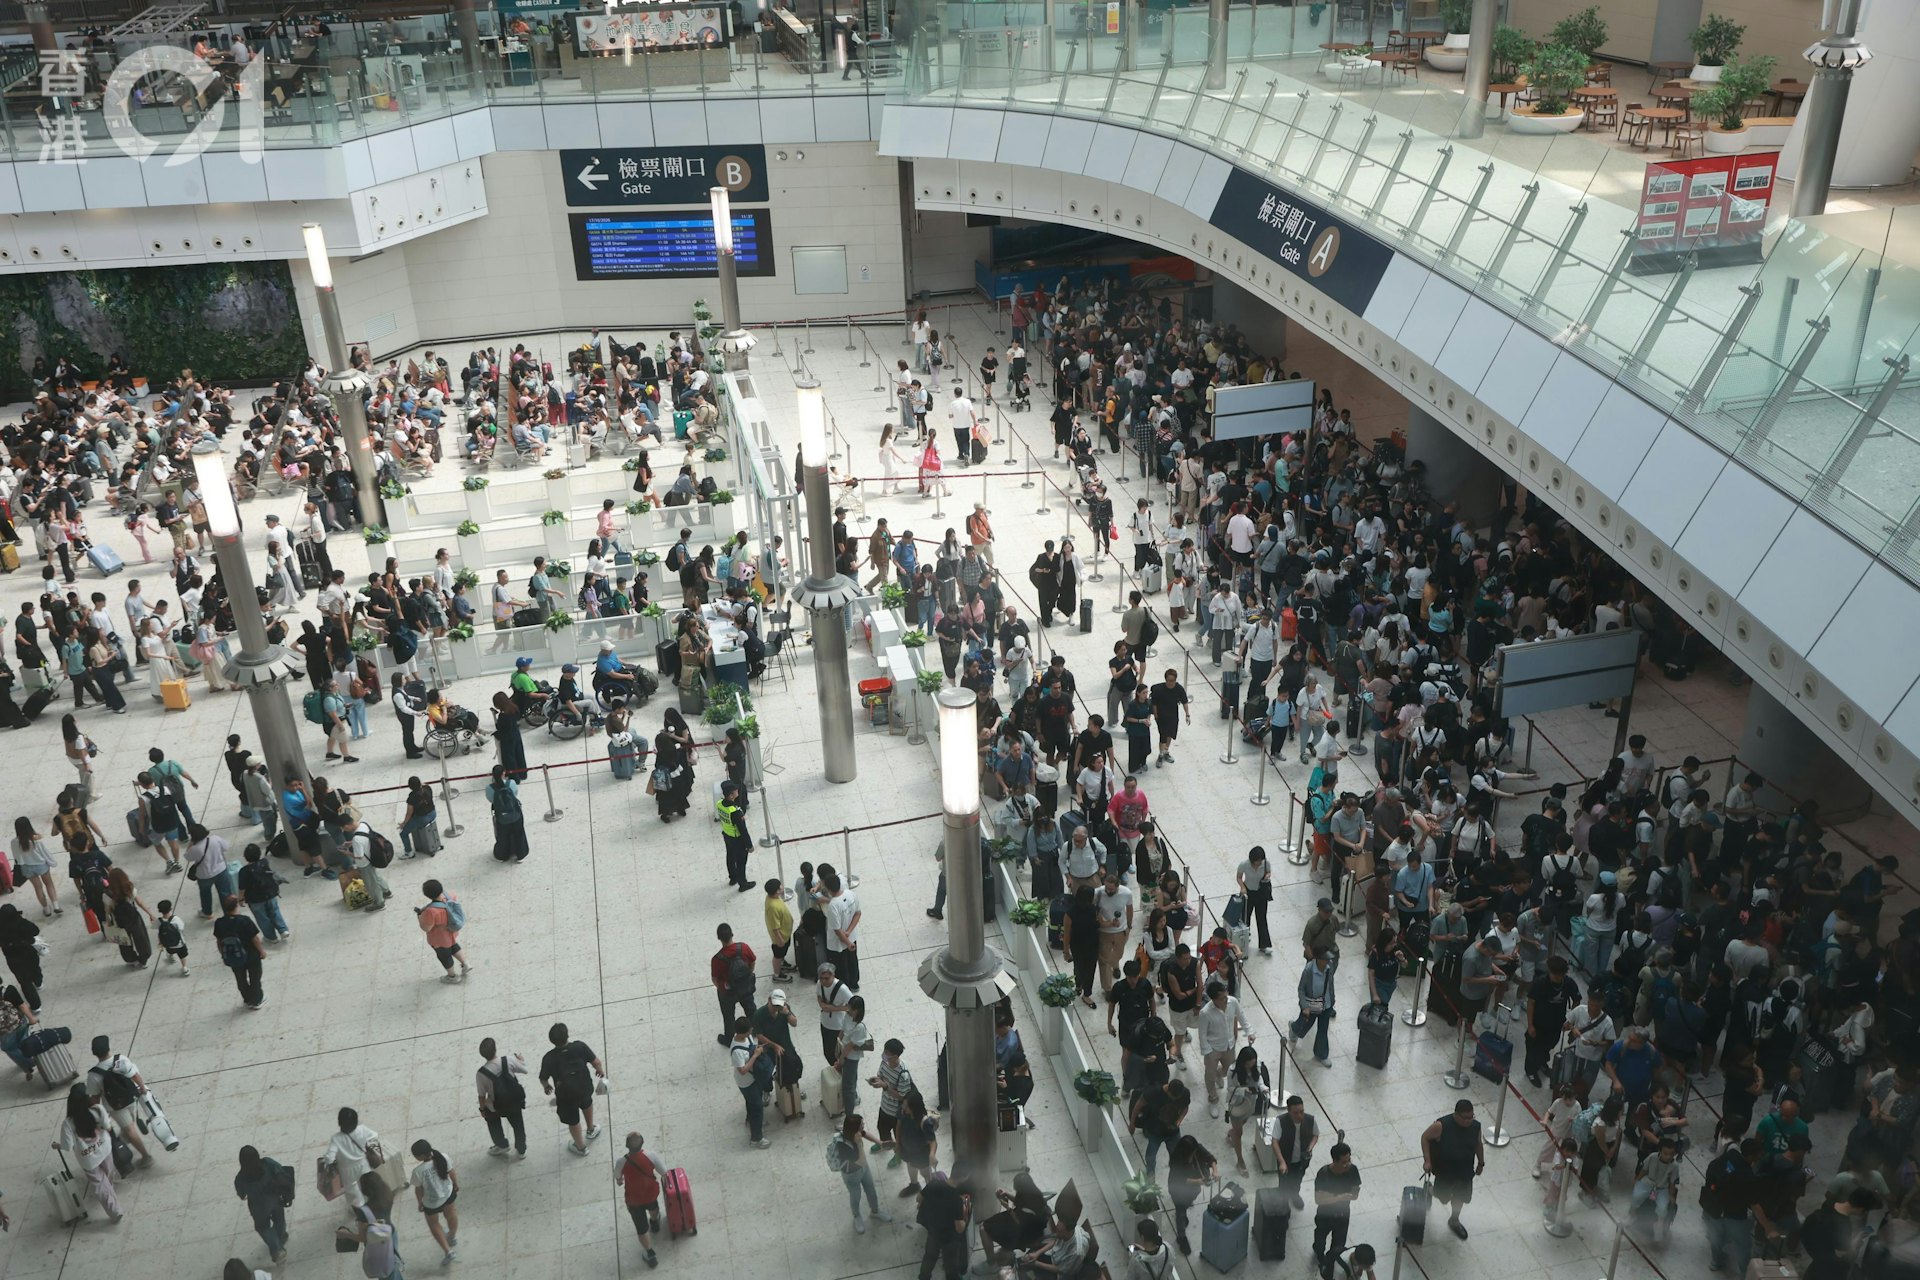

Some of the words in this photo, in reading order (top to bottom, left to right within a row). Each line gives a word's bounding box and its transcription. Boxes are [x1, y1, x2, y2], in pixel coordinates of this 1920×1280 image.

[618, 157, 706, 180] 檢票閘口
[726, 162, 743, 185] B
[621, 182, 651, 195] Gate
[1257, 193, 1316, 245] 檢票閘口
[1280, 241, 1300, 265] Gate
[1311, 234, 1334, 270] A
